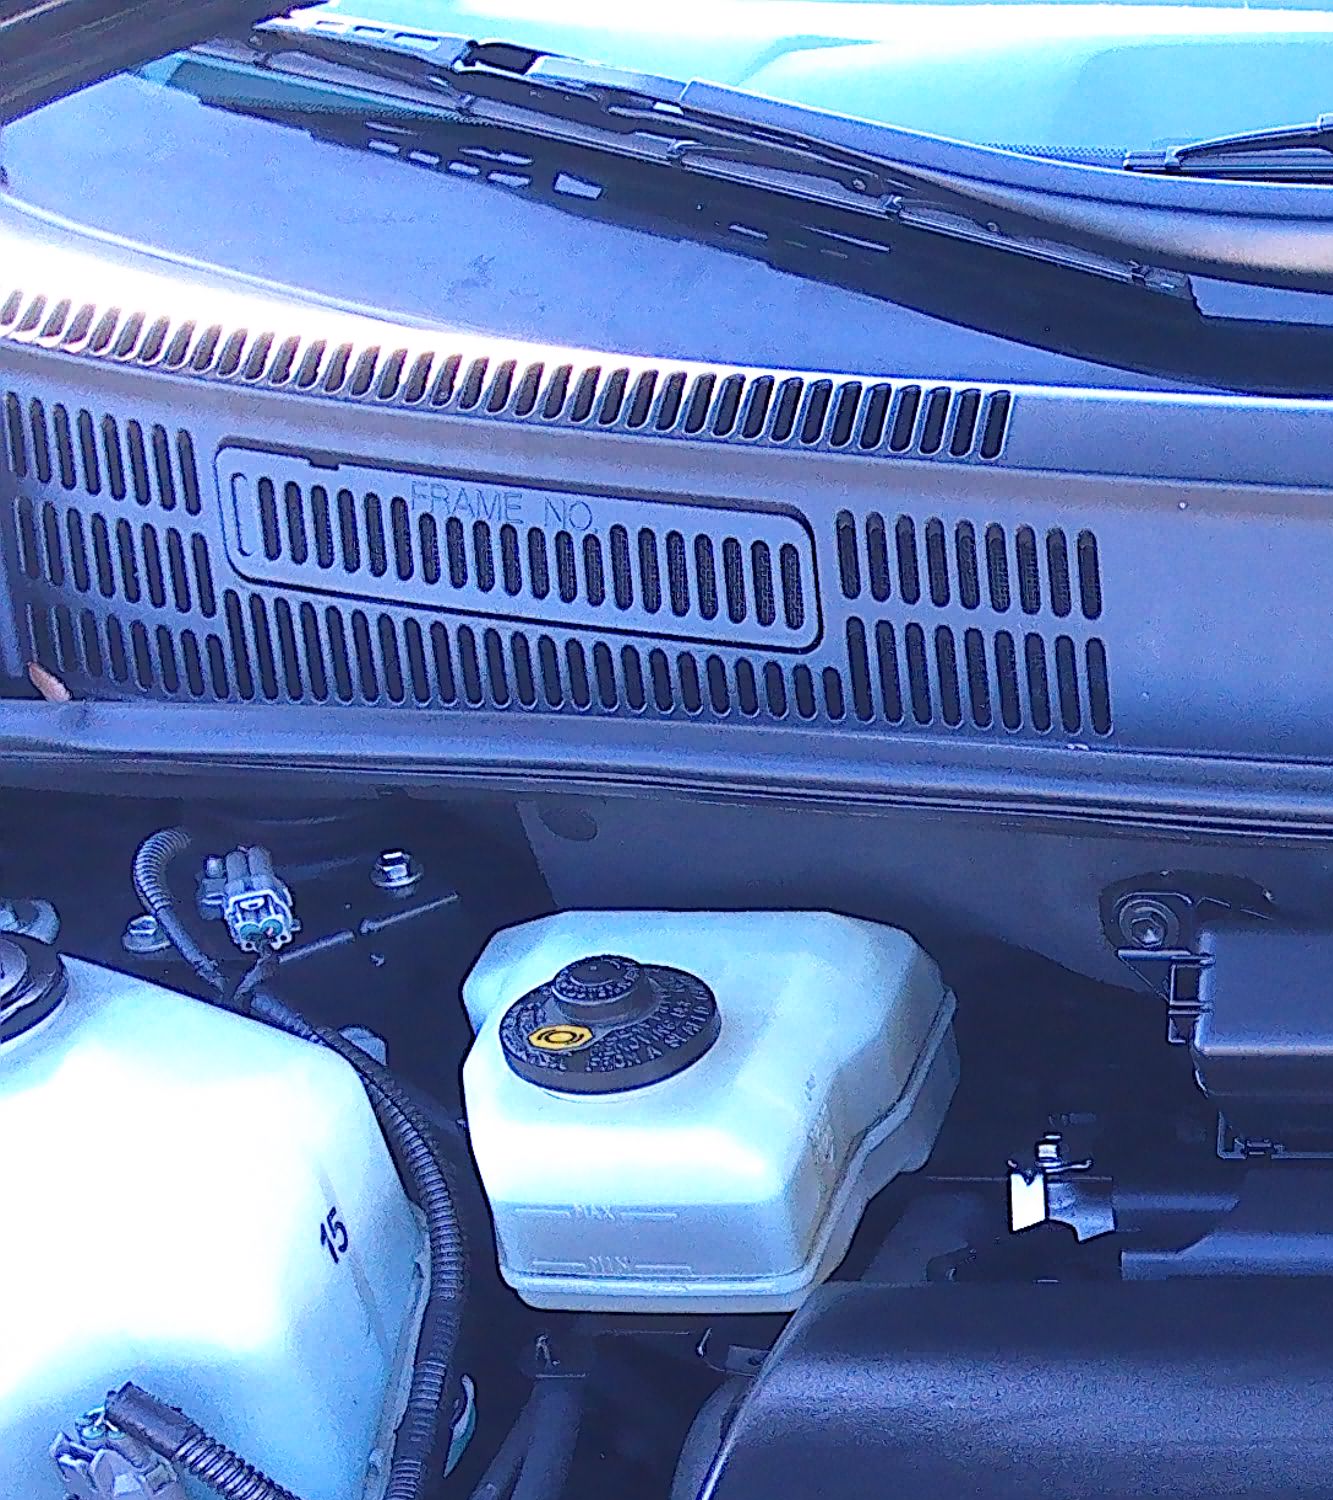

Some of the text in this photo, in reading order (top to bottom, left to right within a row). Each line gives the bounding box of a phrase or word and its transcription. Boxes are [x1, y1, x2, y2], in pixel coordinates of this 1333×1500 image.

[411, 479, 599, 535] FRAME NO.
[320, 1206, 349, 1265] 15
